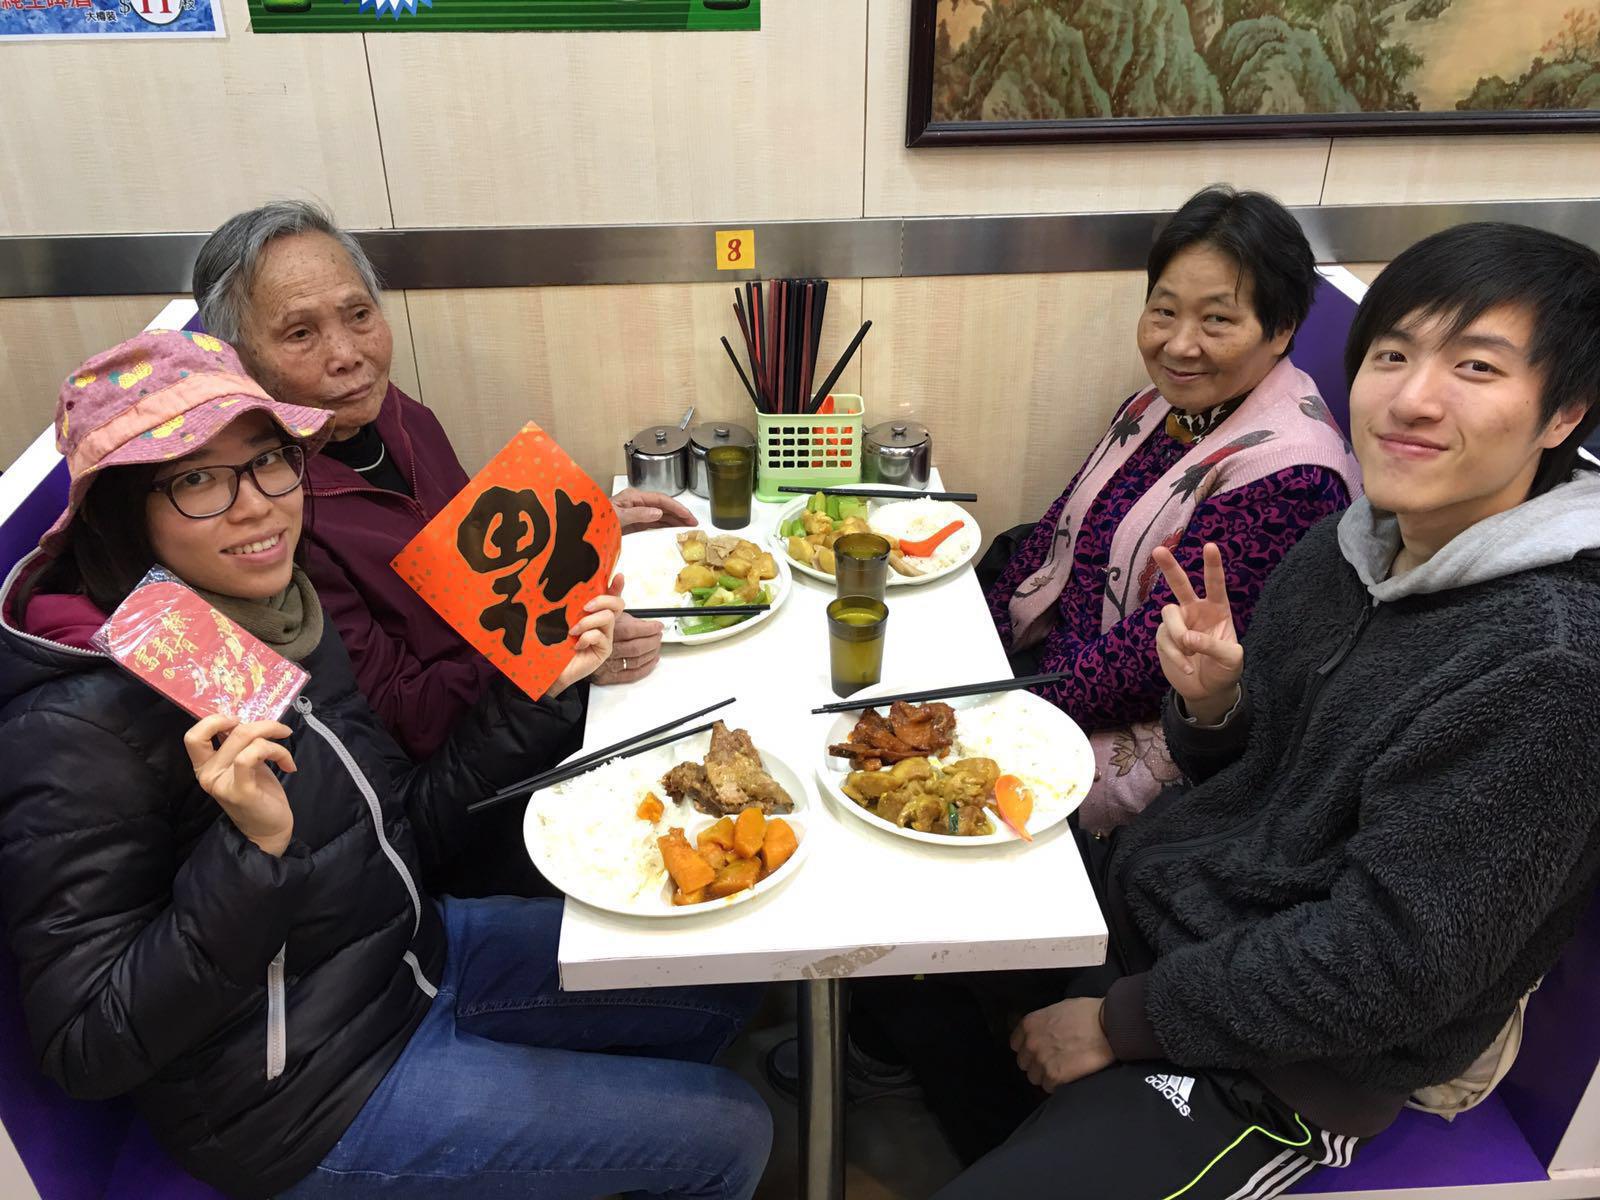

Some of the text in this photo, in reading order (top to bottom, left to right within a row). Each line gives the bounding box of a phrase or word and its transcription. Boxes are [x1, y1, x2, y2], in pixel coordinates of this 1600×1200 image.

[728, 239, 741, 261] 8
[456, 485, 600, 656] 福
[1145, 1075, 1191, 1116] adidas
